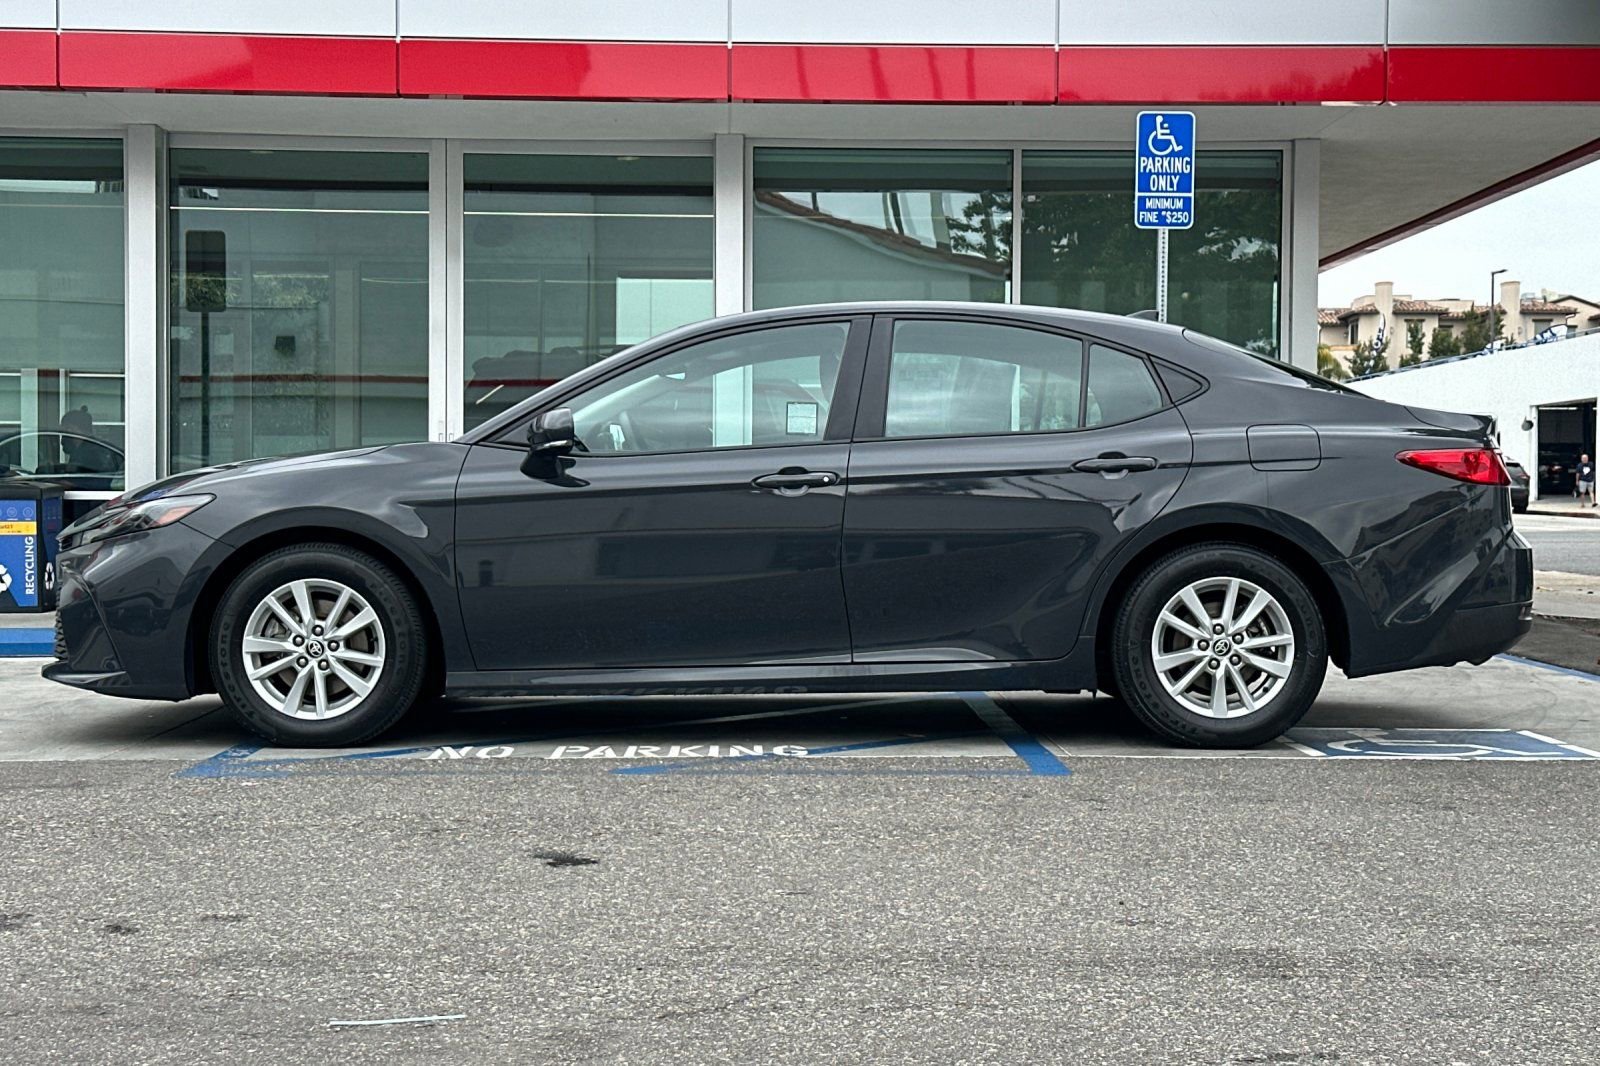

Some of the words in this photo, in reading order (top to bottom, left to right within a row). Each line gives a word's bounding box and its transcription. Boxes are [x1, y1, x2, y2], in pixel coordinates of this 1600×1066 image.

[1140, 156, 1191, 174] PARKING
[1150, 174, 1180, 192] ONLY
[1145, 197, 1184, 210] MINIMUM
[1139, 211, 1159, 223] FINE
[25, 535, 34, 595] RECYCLING
[422, 745, 515, 759] NO
[546, 745, 809, 759] PARKING
